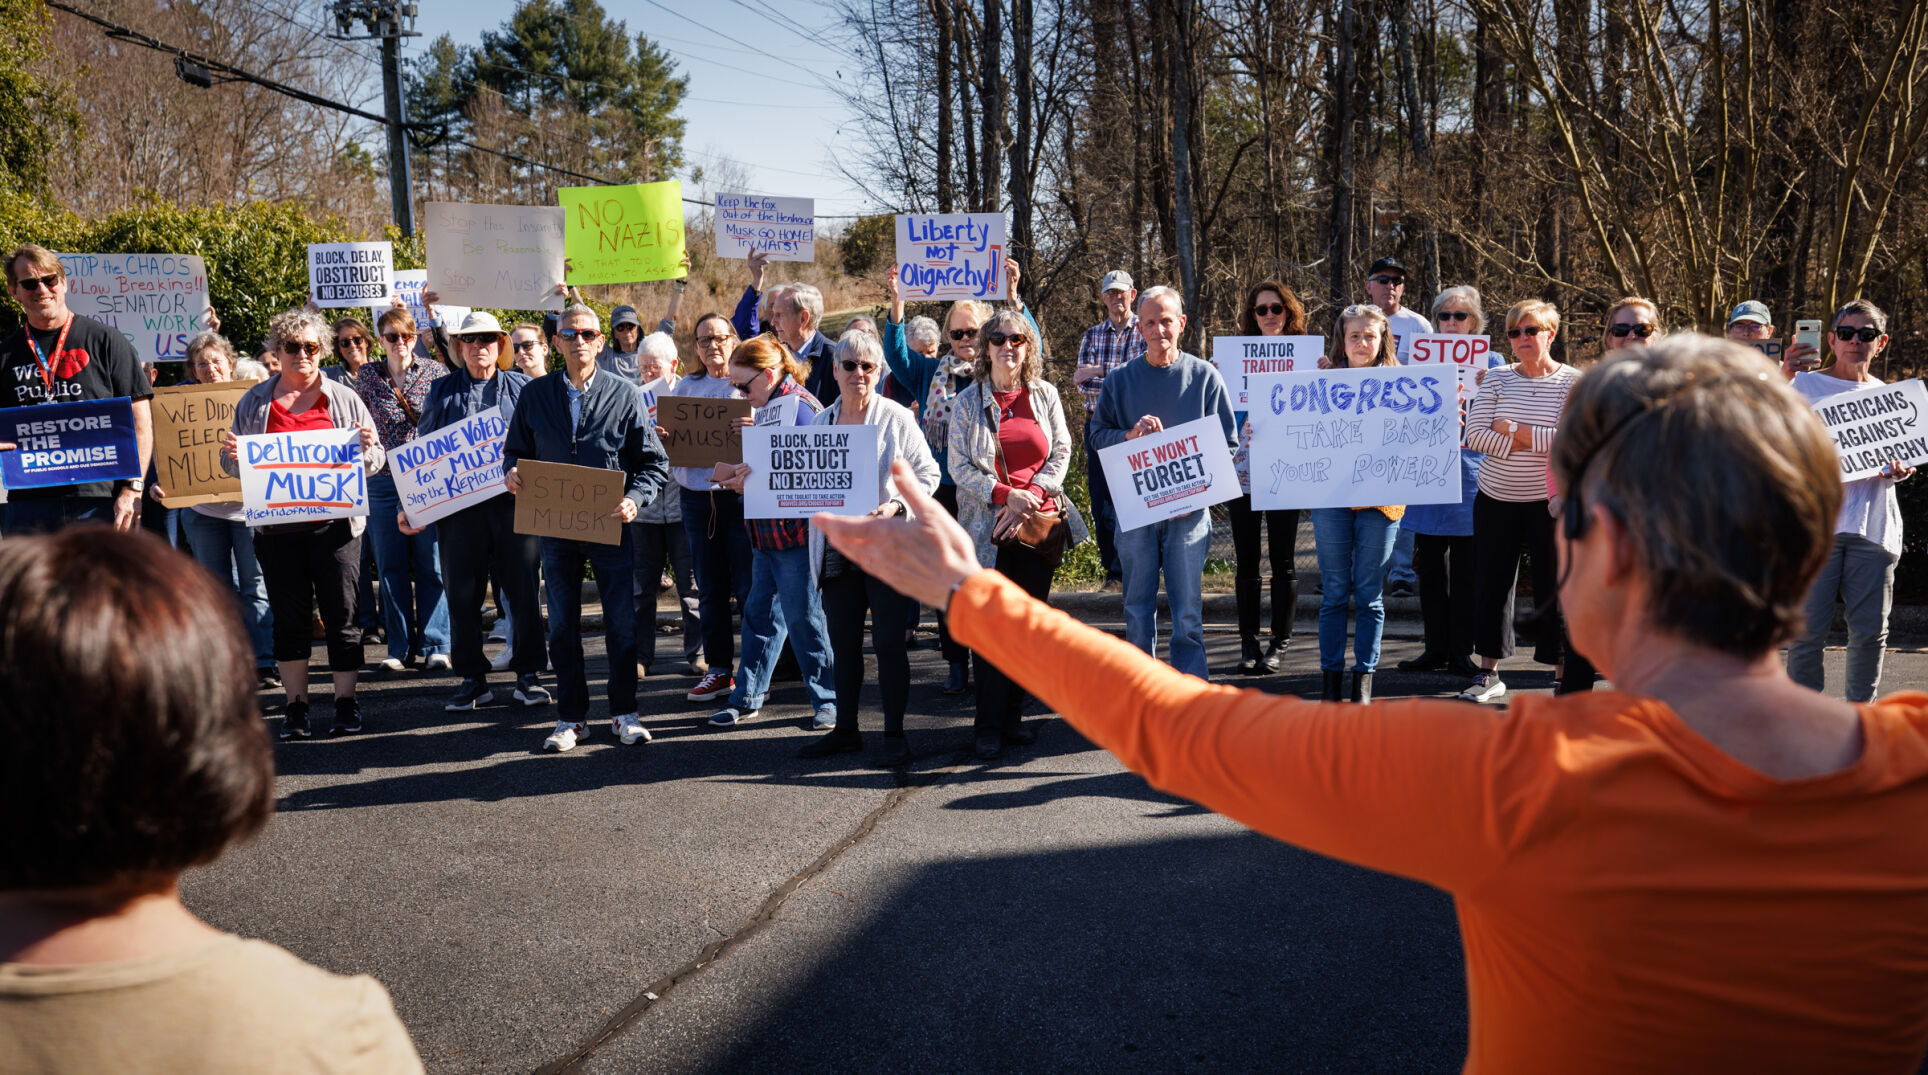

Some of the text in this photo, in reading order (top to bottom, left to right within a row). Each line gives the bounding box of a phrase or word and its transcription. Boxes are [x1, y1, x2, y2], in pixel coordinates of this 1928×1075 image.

[744, 196, 760, 209] the
[761, 197, 776, 209] fox
[439, 211, 478, 232] Stop
[578, 198, 624, 229] NO
[740, 210, 752, 219] of
[757, 210, 774, 221] the
[598, 219, 680, 253] NAZIS
[758, 227, 776, 237] GO
[58, 256, 191, 277] STOP the CHAOS
[315, 250, 384, 265] BLOCK, DELAY,
[81, 278, 111, 295] Law
[115, 275, 203, 295] Breaking!!
[316, 265, 385, 284] OBSTRUCT
[440, 266, 476, 289] Stop
[321, 284, 383, 299] NO EXCUSES
[96, 293, 187, 314] SENATOR
[143, 315, 201, 331] WORK
[1242, 343, 1295, 358] TRAITOR
[1412, 338, 1489, 365] STOP
[12, 363, 43, 381] We
[1242, 359, 1294, 374] TRAITOR
[1270, 376, 1443, 415] CONGRESS
[161, 397, 197, 424] WE
[674, 403, 728, 421] STOP
[15, 415, 112, 437] RESTORE
[1286, 417, 1363, 450] TAKE
[1382, 415, 1450, 447] BACK
[1838, 417, 1907, 449] AGAINST
[18, 435, 61, 451] THE
[178, 427, 231, 448] ELEC
[672, 429, 738, 449] MUSK
[770, 433, 849, 449] BLOCK, DELAY
[20, 445, 117, 468] PROMISE
[396, 445, 425, 473] NO
[426, 430, 462, 461] ONE
[771, 449, 849, 470] OBSTUCT
[1127, 435, 1199, 471] WE WON'T
[415, 441, 504, 486] for MUSK
[1269, 448, 1458, 495] YOUR POWER!
[772, 472, 850, 489] NO EXCUSES
[1132, 453, 1206, 496] FORGET
[407, 491, 428, 507] Stop
[428, 486, 447, 500] the
[533, 475, 608, 504] STOP
[533, 508, 611, 532] MUSK
